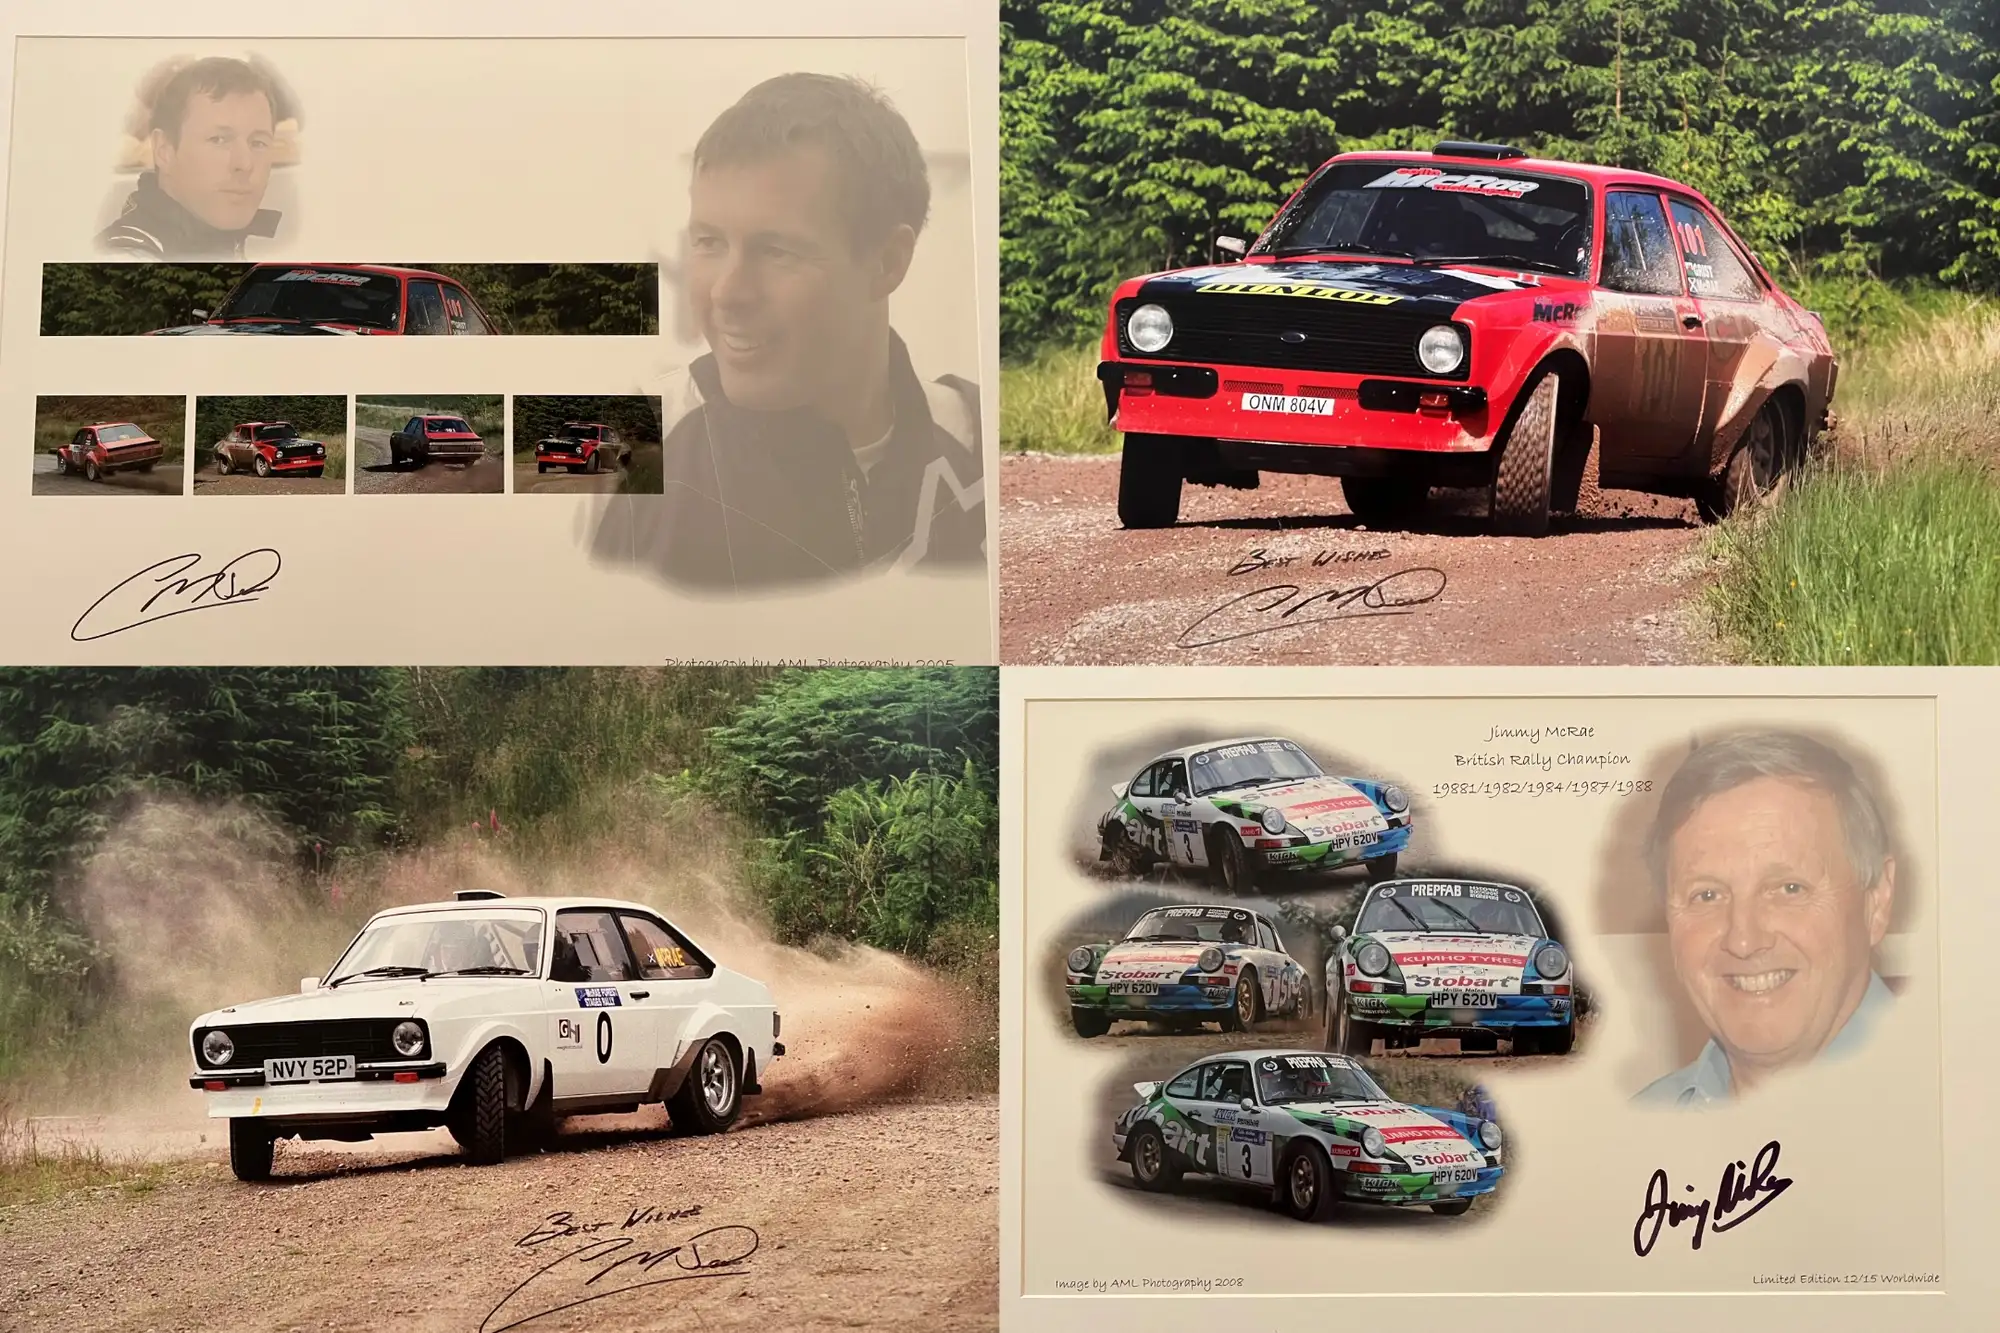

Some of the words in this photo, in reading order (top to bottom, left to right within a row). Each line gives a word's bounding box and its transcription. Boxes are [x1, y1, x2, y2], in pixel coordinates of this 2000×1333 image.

[1201, 284, 1398, 303] DUNLOP
[1249, 395, 1287, 411] ONM
[1290, 396, 1328, 414] 804V
[1484, 725, 1540, 743] Jimmy
[1545, 726, 1595, 738] McRae
[1454, 753, 1505, 767] British
[1510, 753, 1551, 771] Rally
[1556, 752, 1632, 769] Champion
[1183, 833, 1194, 863] 3
[1332, 839, 1351, 850] HPY
[1353, 832, 1377, 846] 620V
[1411, 885, 1461, 897] PREPFAB
[1469, 955, 1523, 964] TYRES
[1110, 984, 1129, 993] HPY
[1132, 983, 1158, 994] 620V
[1432, 993, 1458, 1006] HPY
[1462, 994, 1497, 1006] 620V
[272, 1061, 307, 1078] NVY
[313, 1059, 347, 1076] 52P
[1242, 1144, 1252, 1178] 3
[1413, 1152, 1479, 1166] Stobart
[1434, 1170, 1452, 1182] HPY
[1455, 1169, 1477, 1181] 620V
[1055, 1278, 1090, 1292] Image
[1092, 1279, 1107, 1292] by
[1110, 1279, 1139, 1288] AML
[1142, 1277, 1212, 1292] Photography
[1214, 1277, 1244, 1287] 2008
[1752, 1274, 1796, 1284] Limited
[1800, 1274, 1841, 1284] Edition
[1844, 1274, 1878, 1284] 12/15
[1880, 1273, 1940, 1283] Worldwide
